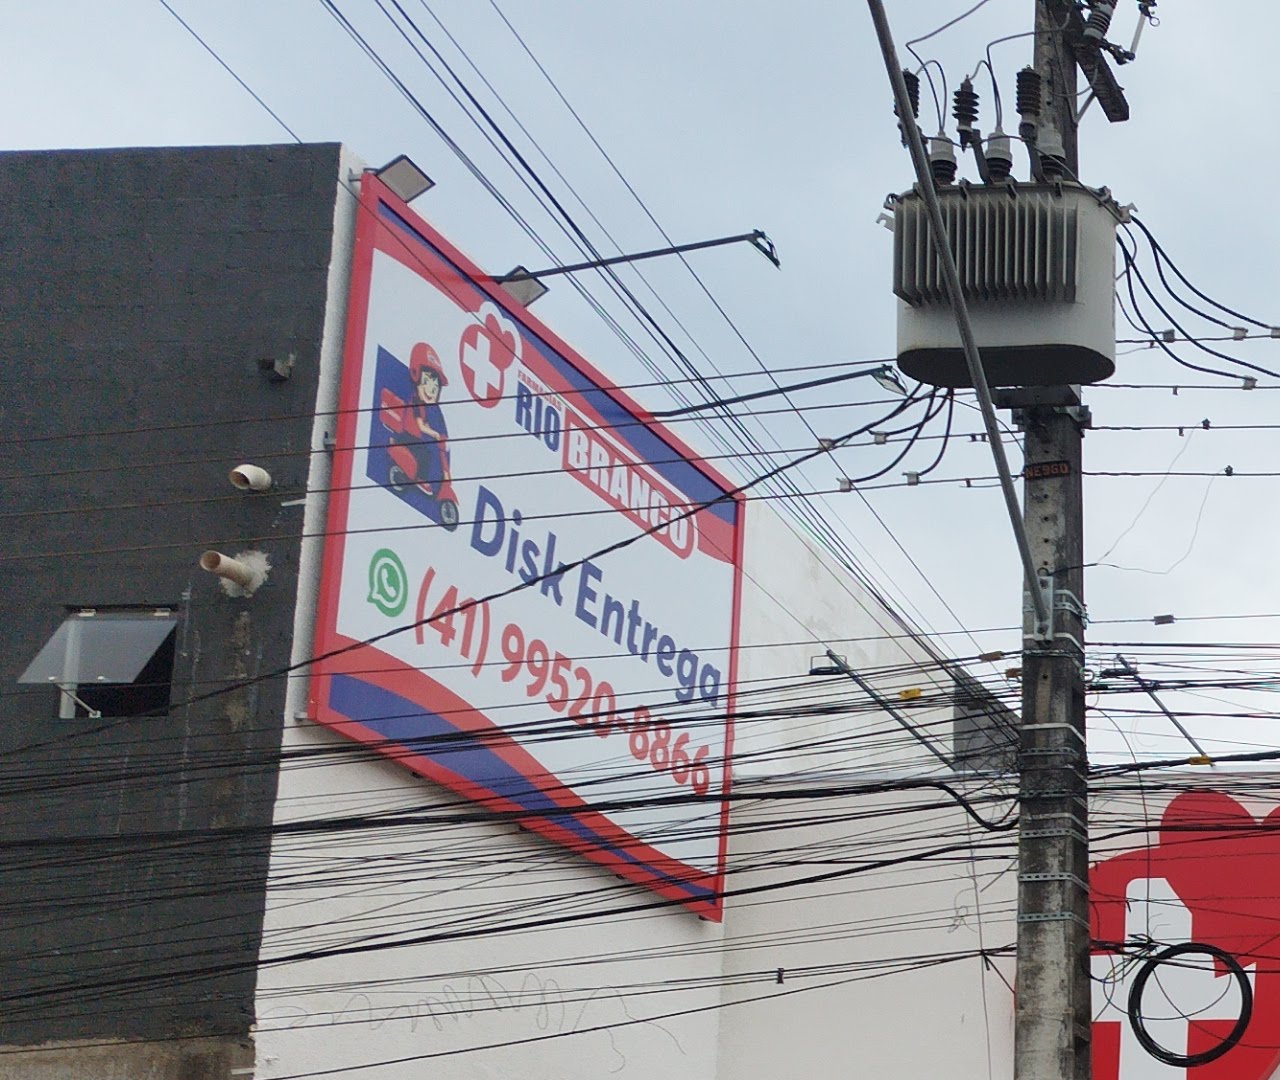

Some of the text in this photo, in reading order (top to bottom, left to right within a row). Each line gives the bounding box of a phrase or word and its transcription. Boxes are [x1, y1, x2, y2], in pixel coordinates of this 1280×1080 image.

[514, 381, 690, 552] RIO BRANCO
[414, 566, 711, 796] (41) 99520-8866
[470, 484, 722, 708] Disk Entrega
